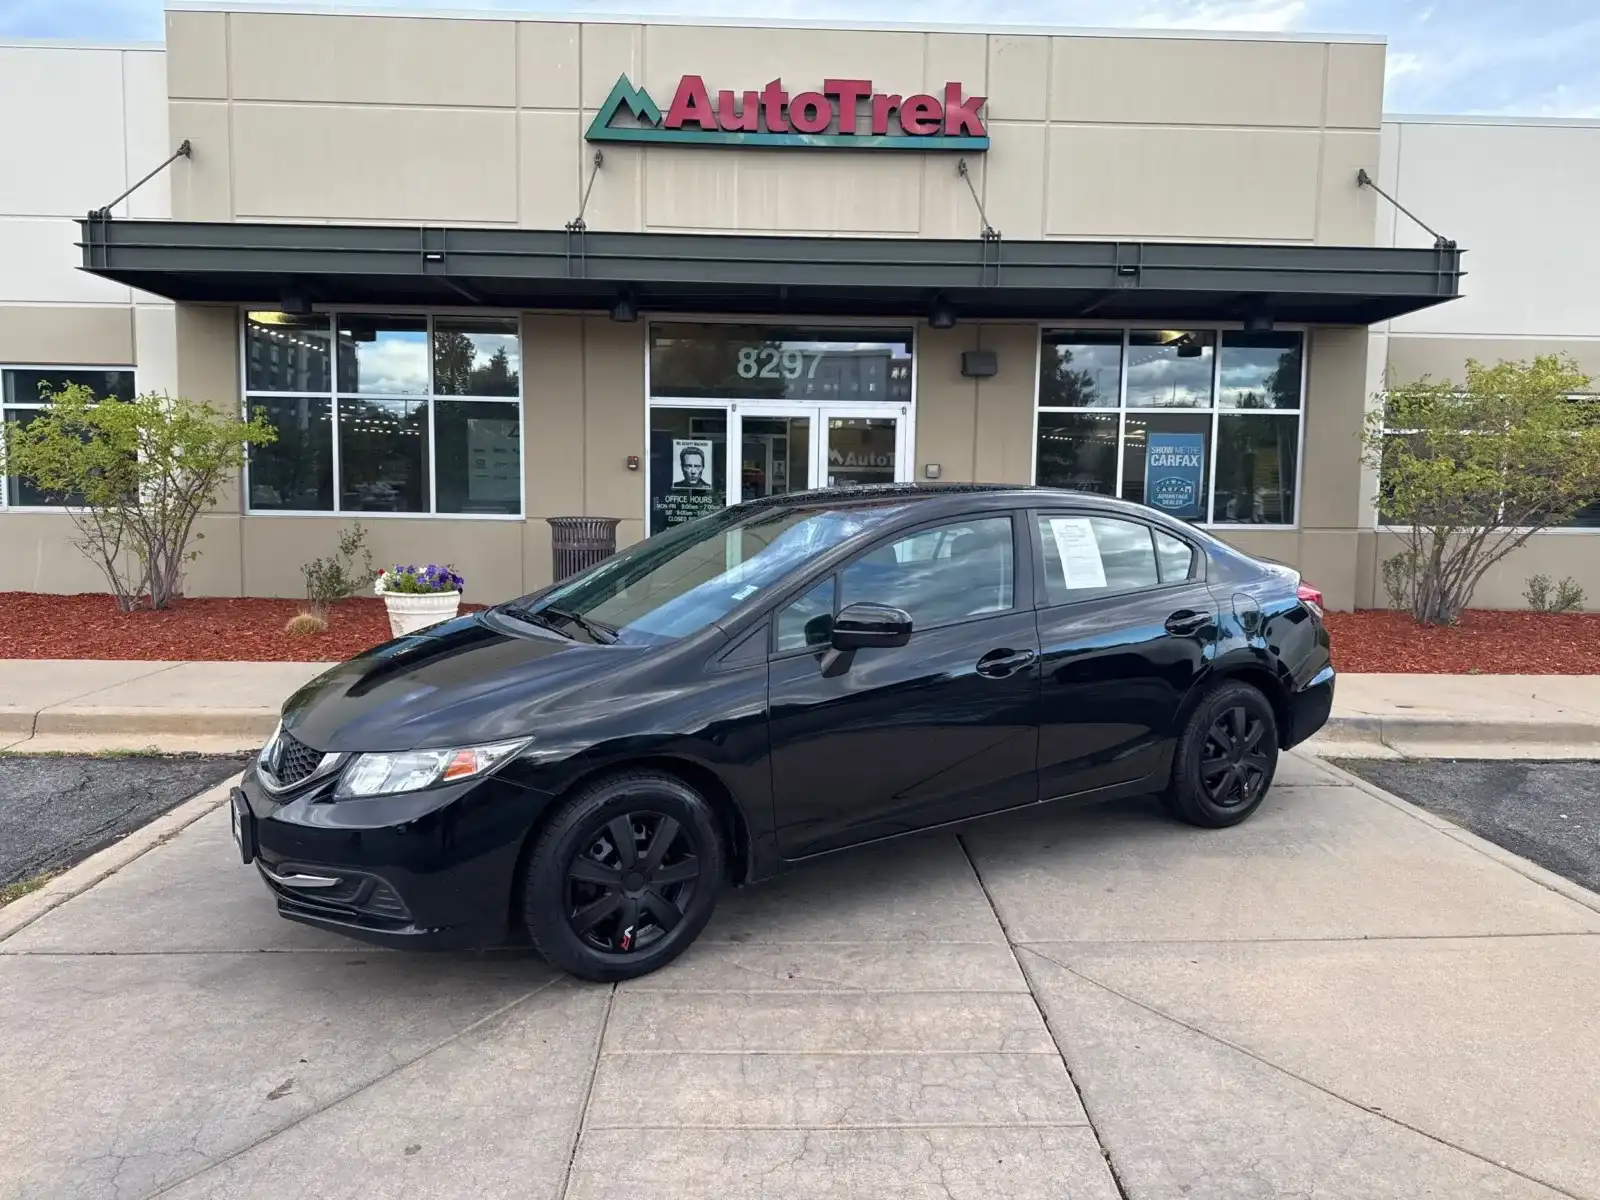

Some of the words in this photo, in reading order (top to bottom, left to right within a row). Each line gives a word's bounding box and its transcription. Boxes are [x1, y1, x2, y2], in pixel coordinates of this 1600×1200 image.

[664, 75, 988, 136] AutoTrek
[737, 347, 824, 379] 8297
[1151, 446, 1173, 454] SHOW
[1151, 454, 1199, 467] CARFAX
[665, 495, 687, 503] OFFICE
